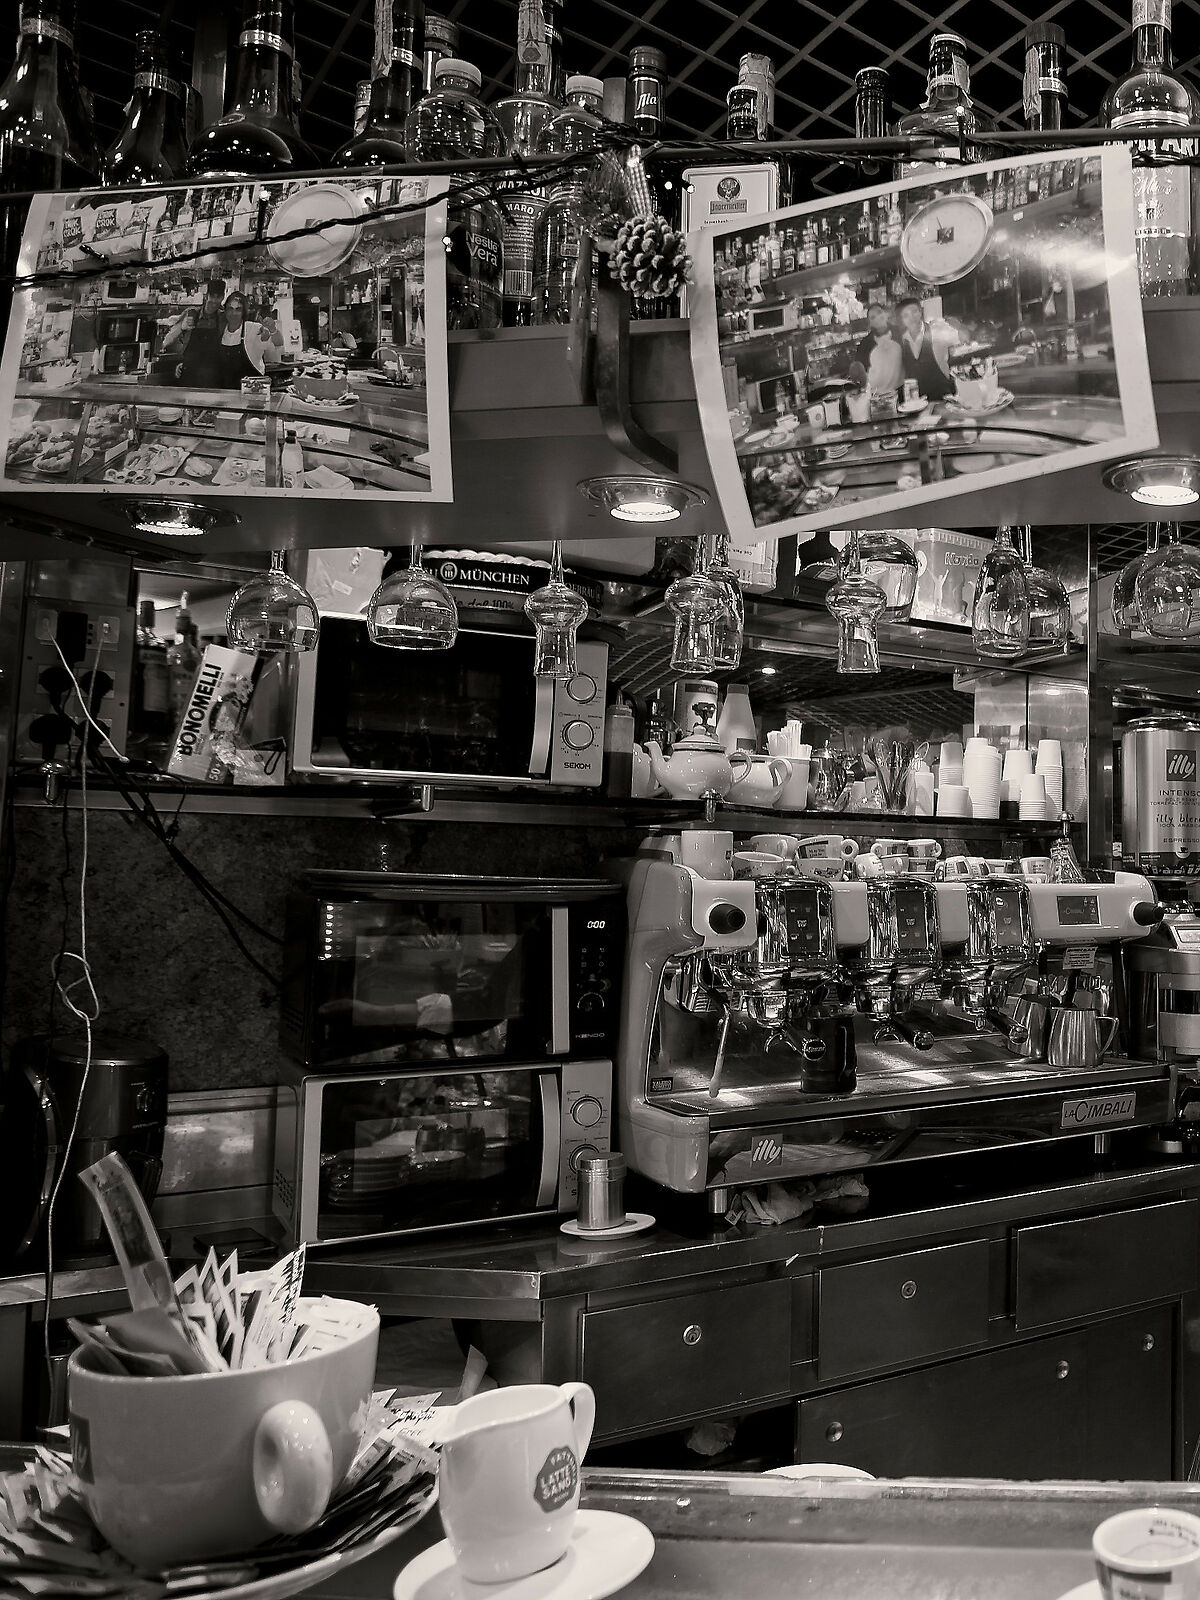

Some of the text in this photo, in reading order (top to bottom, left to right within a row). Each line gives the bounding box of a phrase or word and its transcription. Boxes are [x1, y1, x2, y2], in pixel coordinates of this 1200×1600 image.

[505, 203, 534, 215] MARO
[465, 241, 498, 267] Vera
[459, 568, 530, 585] MÜNCHEN
[179, 663, 222, 757] BONOMELLI
[563, 762, 592, 770] SEKOM
[1168, 753, 1195, 779] illy
[1156, 813, 1173, 824] illy
[1064, 1100, 1133, 1122] LA CIMBALI
[752, 1139, 781, 1165] illy
